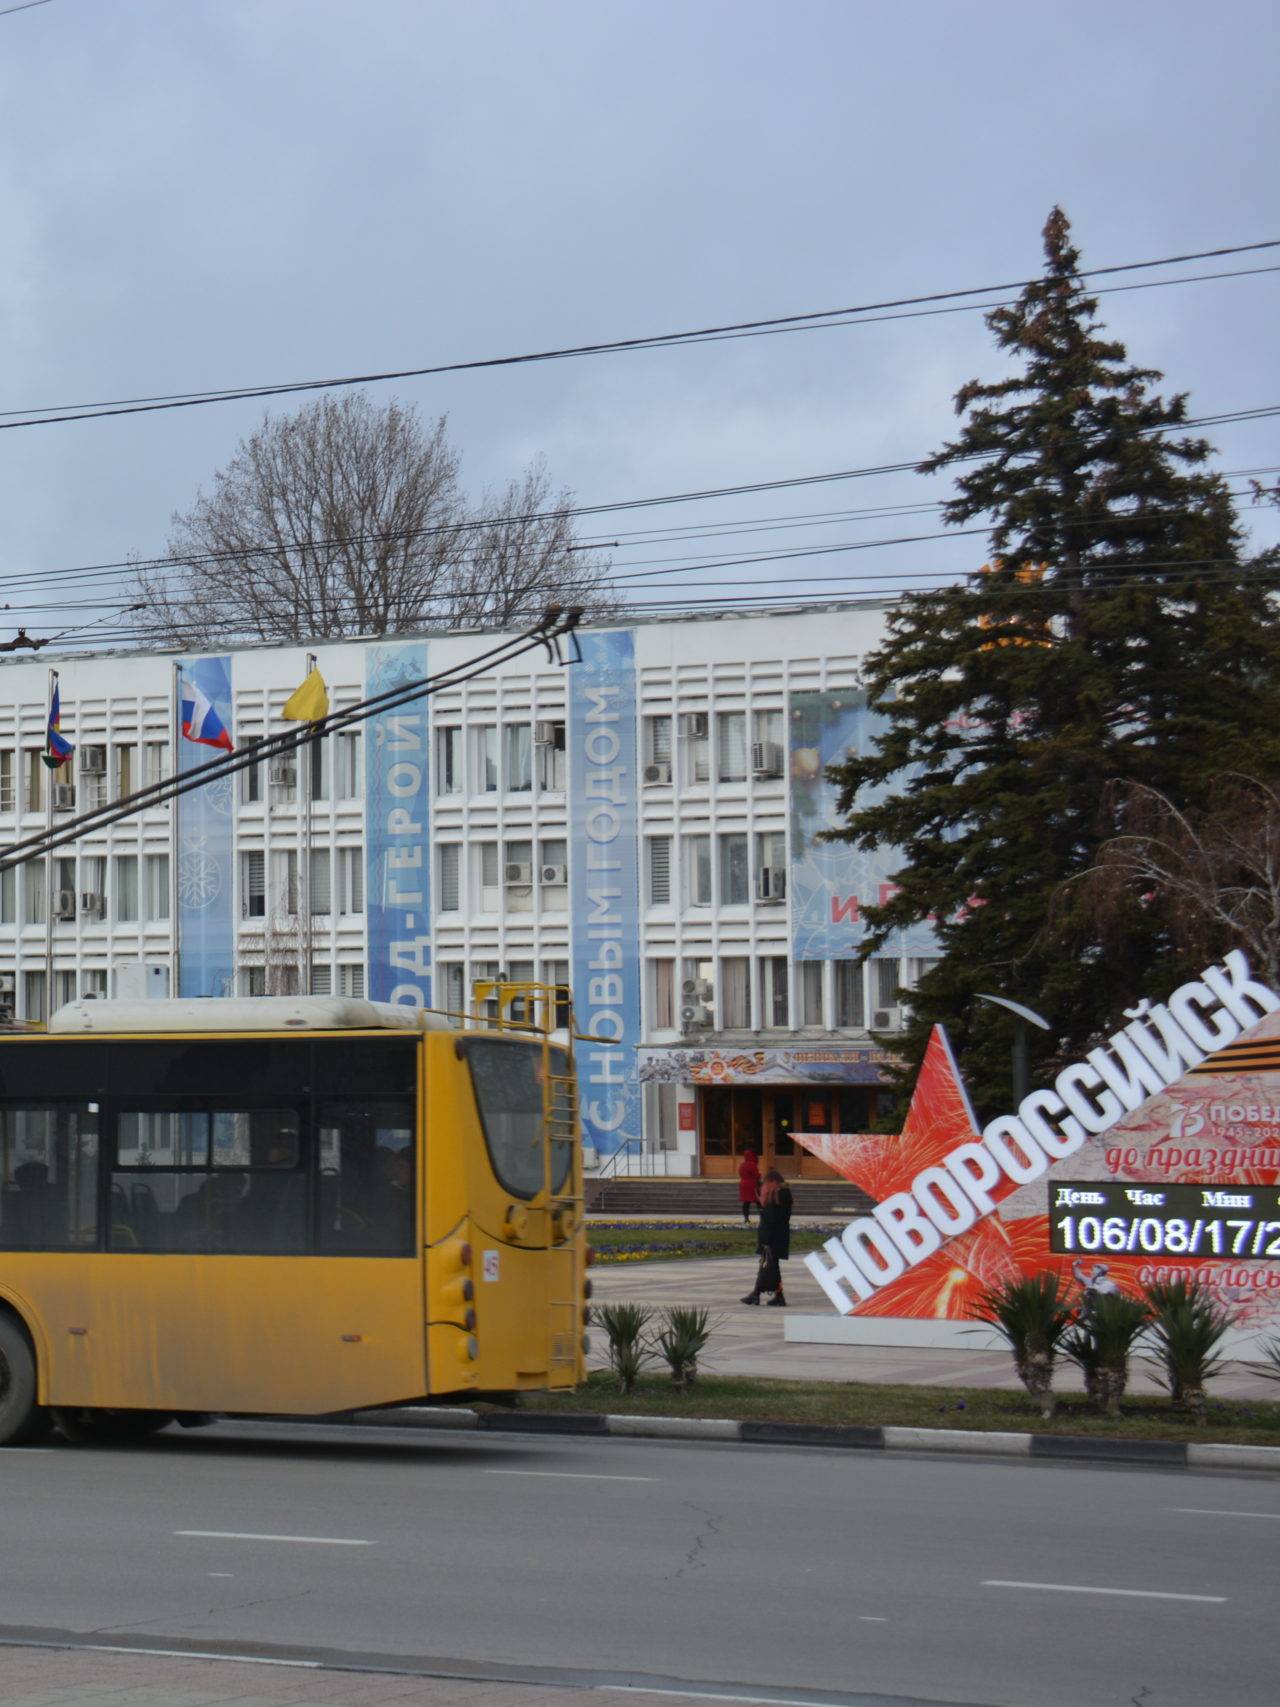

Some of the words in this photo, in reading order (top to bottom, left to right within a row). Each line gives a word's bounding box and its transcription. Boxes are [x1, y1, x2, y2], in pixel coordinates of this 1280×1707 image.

[584, 686, 626, 871] ГОДОМ
[375, 715, 433, 1007] ОД-ГЕРОЙ
[587, 885, 625, 1085] НОВЫМ
[589, 1100, 625, 1132] С
[803, 948, 1280, 1316] НОВОРОССИЙСК
[1211, 1104, 1280, 1125] ПОБЕ
[1105, 1147, 1138, 1173] до
[1146, 1147, 1280, 1175] праздни
[1055, 1188, 1105, 1207] День
[1124, 1189, 1165, 1206] Час
[1201, 1191, 1251, 1208] Мин
[1057, 1216, 1280, 1256] 106/08/17/2
